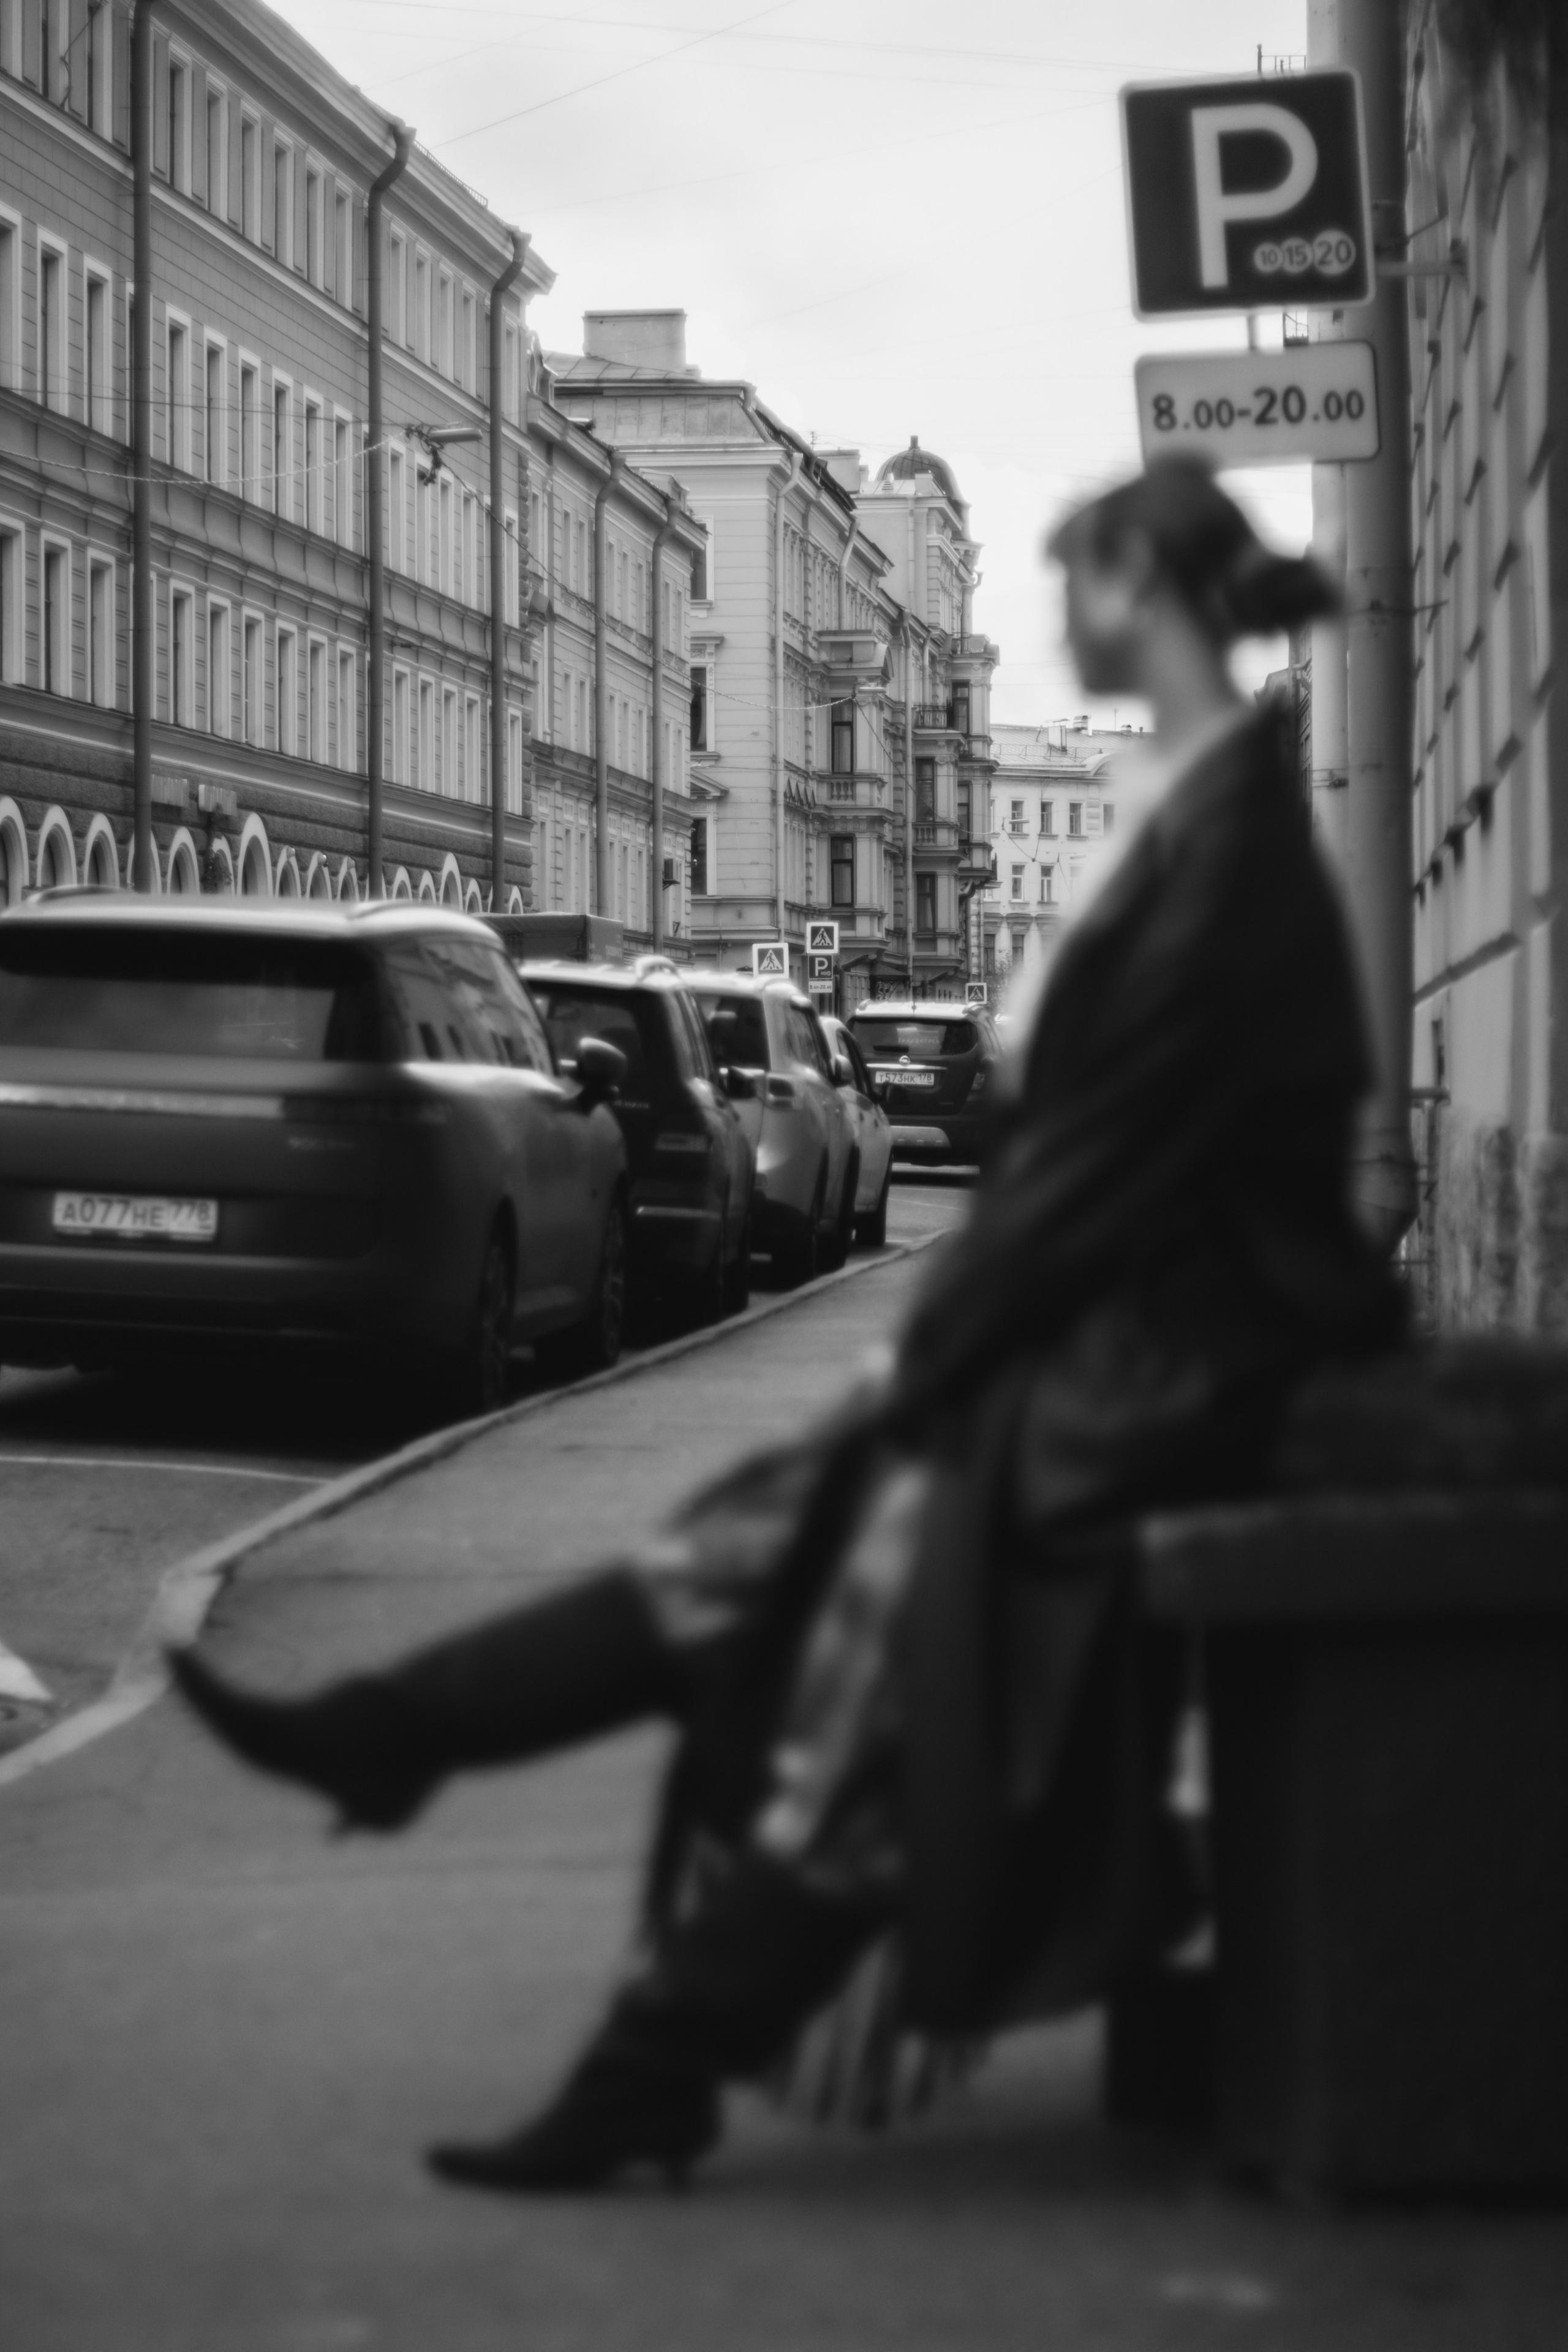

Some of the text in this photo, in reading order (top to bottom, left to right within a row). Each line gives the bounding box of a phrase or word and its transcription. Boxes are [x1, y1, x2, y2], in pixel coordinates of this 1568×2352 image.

[1191, 102, 1319, 289] P
[1260, 238, 1352, 266] 10 15 20
[1153, 384, 1365, 431] 8.00-20.00
[815, 957, 828, 976] P
